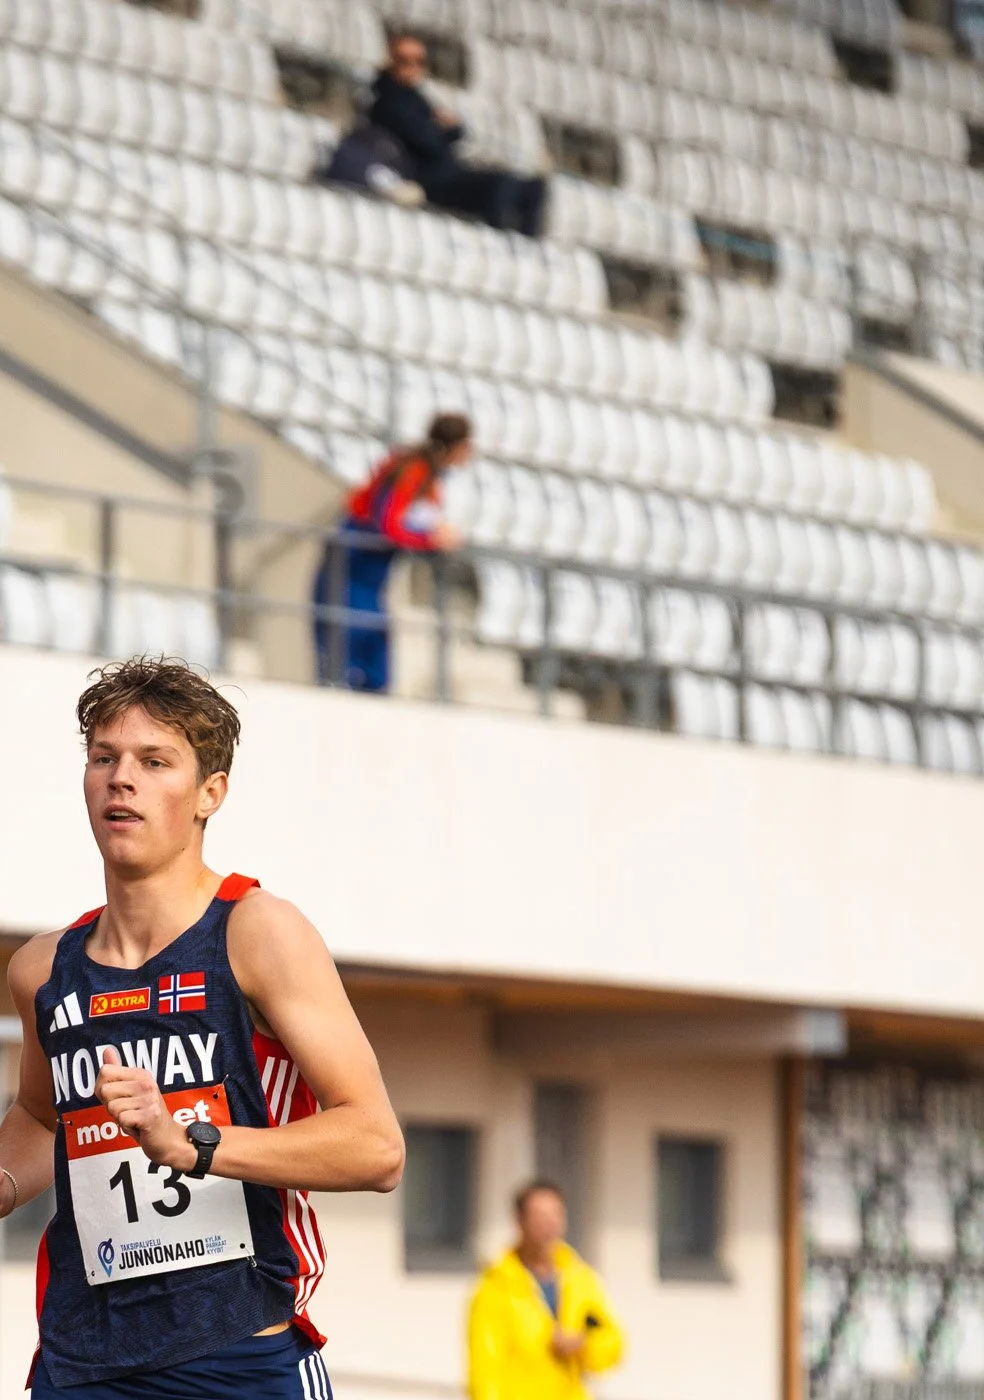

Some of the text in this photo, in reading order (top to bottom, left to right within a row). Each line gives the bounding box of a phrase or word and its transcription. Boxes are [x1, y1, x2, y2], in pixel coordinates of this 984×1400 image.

[110, 994, 146, 1008] EXTRA
[109, 1160, 191, 1224] 13
[119, 1239, 205, 1270] JUNNONAHO
[120, 1238, 161, 1252] TAKSIPALVELU
